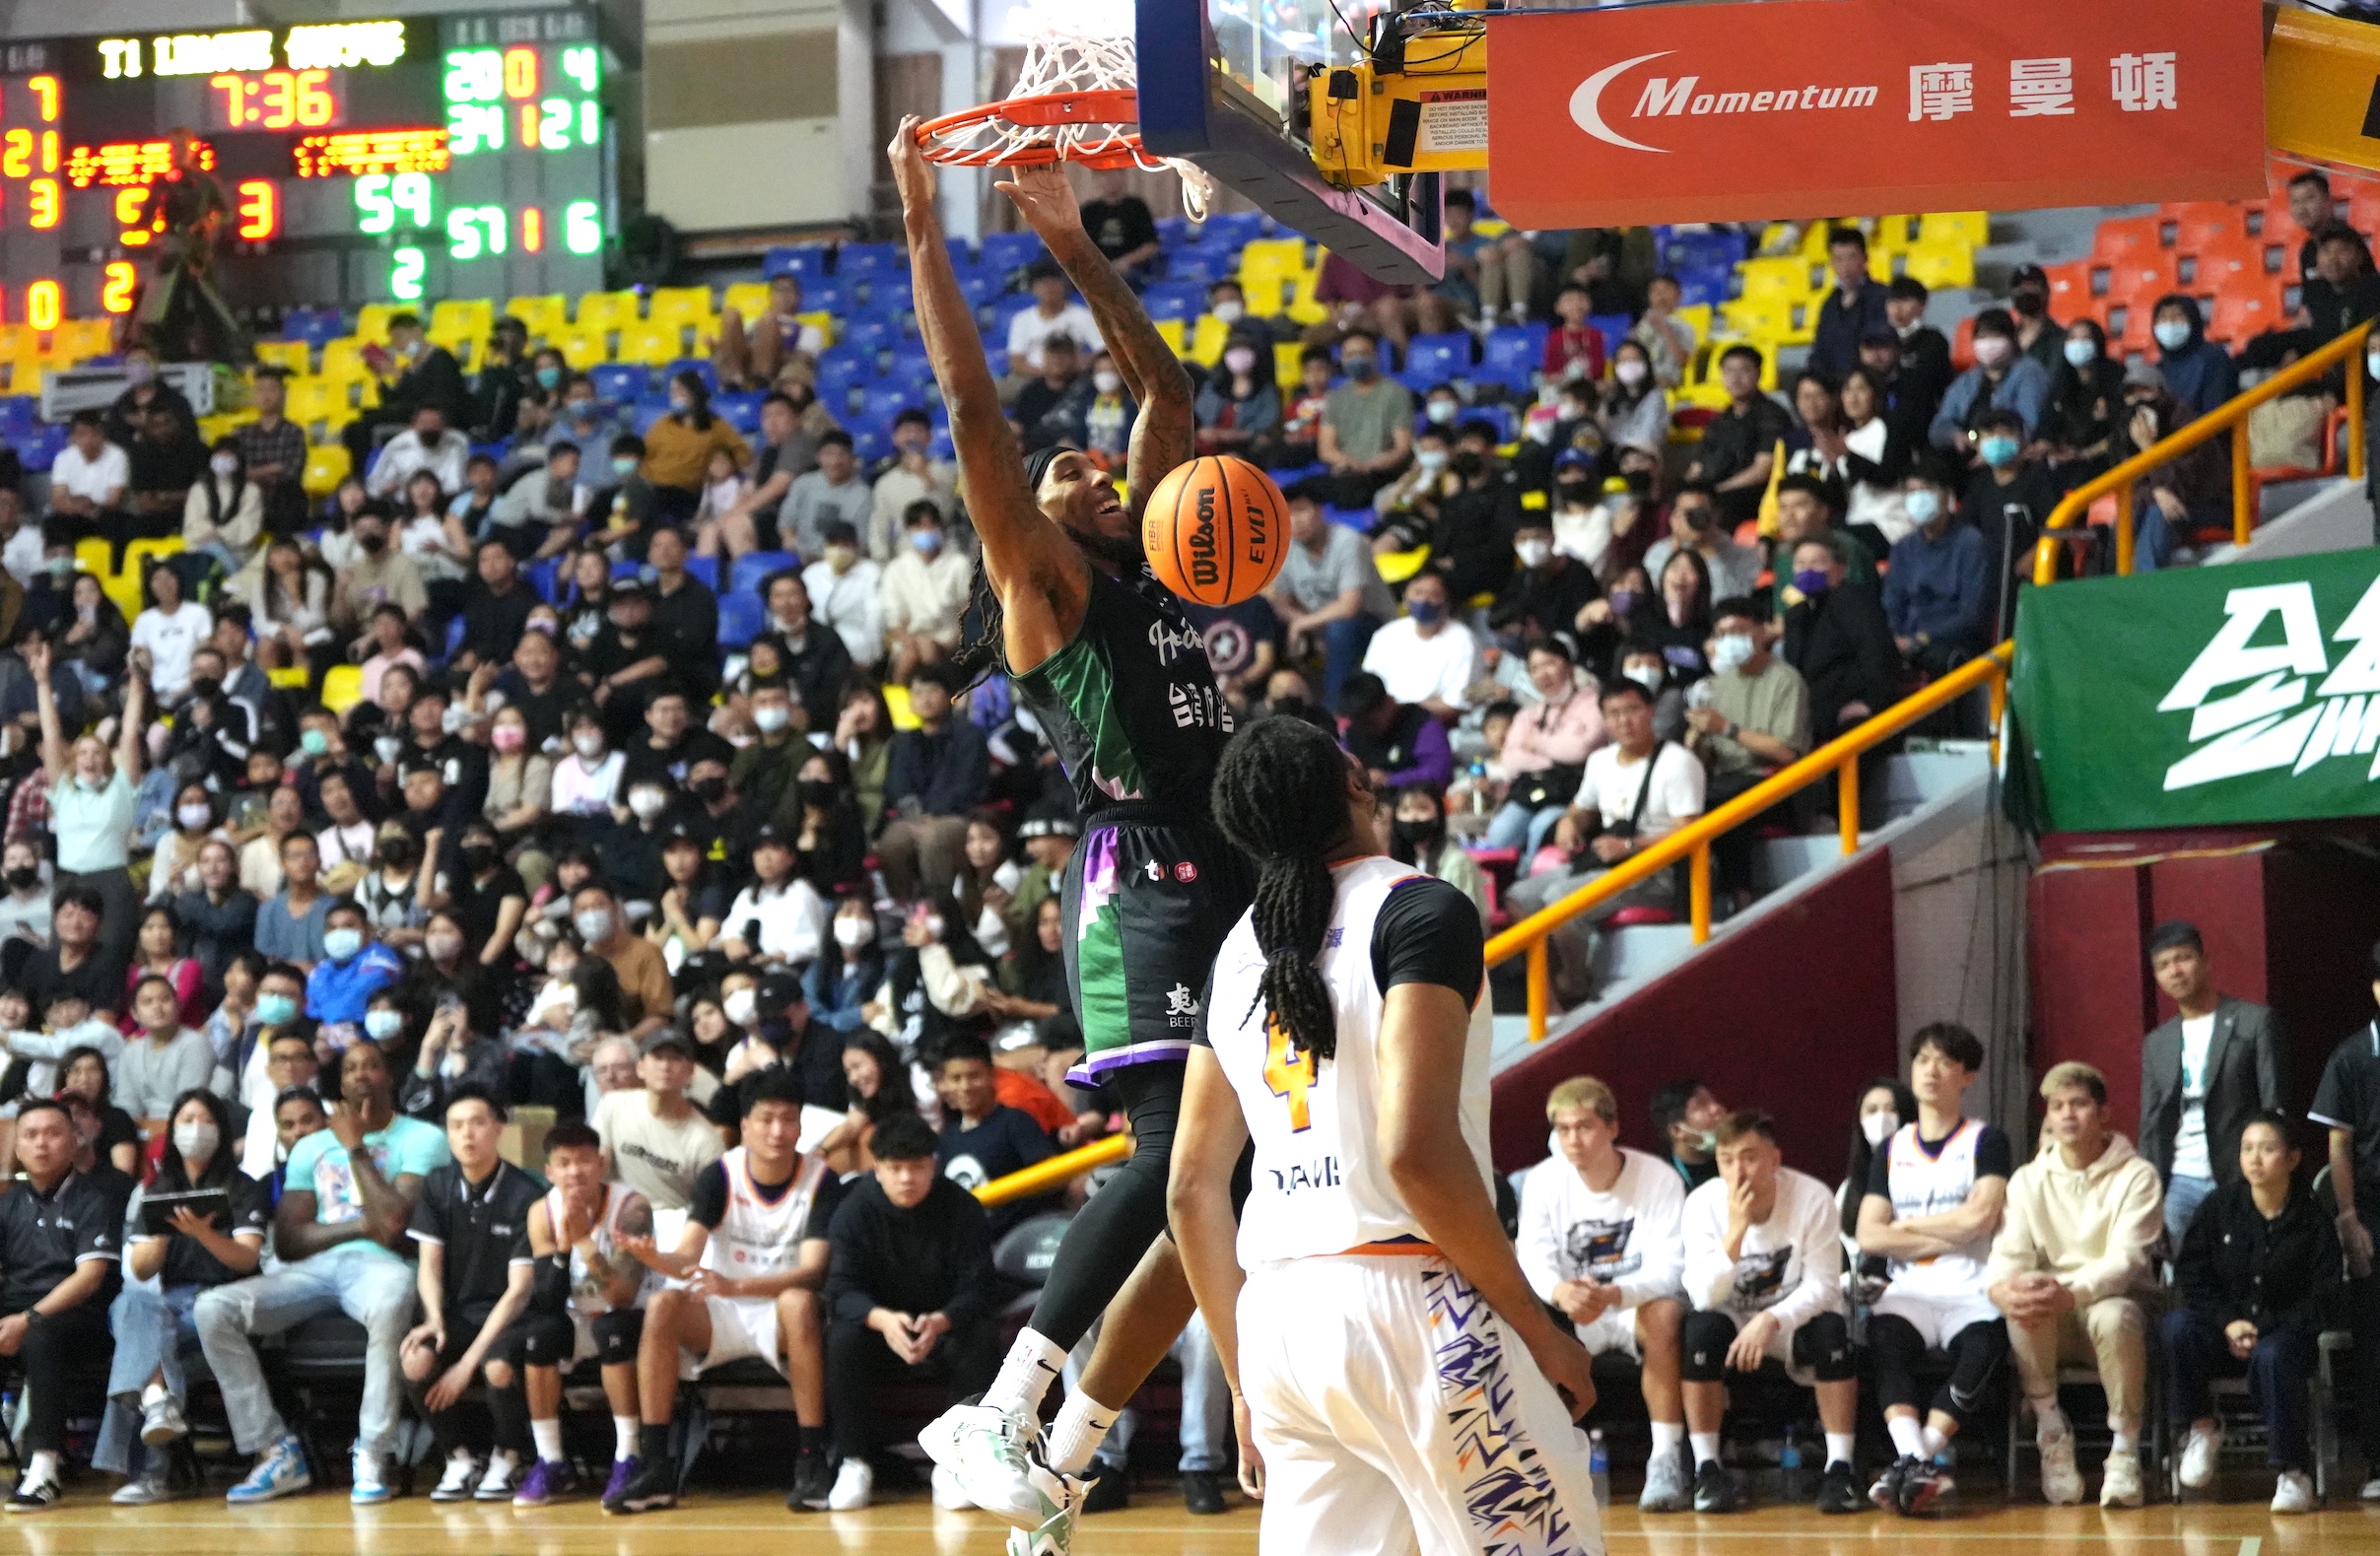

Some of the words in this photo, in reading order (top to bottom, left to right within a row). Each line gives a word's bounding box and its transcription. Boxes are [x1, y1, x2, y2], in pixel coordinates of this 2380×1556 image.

[99, 38, 142, 79] T1
[506, 48, 536, 98] 0
[564, 47, 597, 92] 4
[28, 76, 57, 122] 7
[210, 69, 334, 129] 7:36
[1631, 75, 1878, 118] Momentum
[1908, 52, 2178, 122] 摩曼頓
[3, 128, 58, 177] 21
[30, 177, 58, 229] 3
[238, 180, 274, 239] 3
[354, 171, 431, 234] 59
[447, 206, 507, 259] 57
[523, 208, 540, 252] 1
[566, 201, 601, 253] 6
[103, 261, 135, 313] 2
[392, 247, 426, 300] 2
[28, 280, 60, 331] 0
[1148, 519, 1157, 552] FIBA
[1190, 486, 1219, 586] Wilson
[1165, 981, 1199, 1016] 爽
[1262, 1009, 1320, 1133] 4
